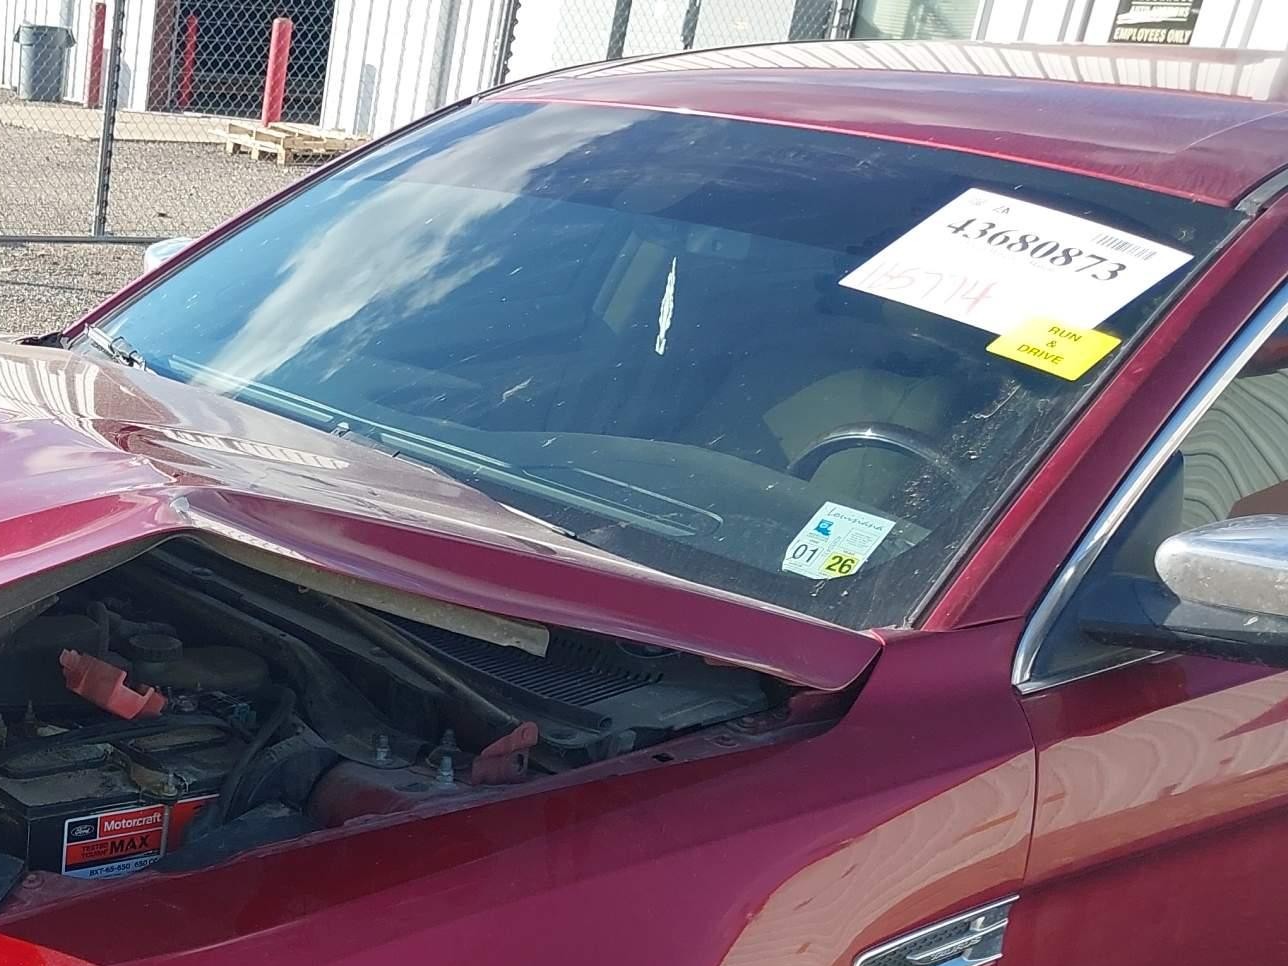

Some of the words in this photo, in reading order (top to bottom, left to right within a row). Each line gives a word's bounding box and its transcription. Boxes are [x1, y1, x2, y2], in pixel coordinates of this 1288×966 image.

[1113, 27, 1166, 42] EMPLOYEES
[1167, 29, 1192, 43] ONLY
[947, 218, 1127, 281] 43680873
[1048, 326, 1082, 342] RUN
[1046, 340, 1057, 348] &
[1016, 344, 1064, 365] DRIVE
[792, 544, 819, 563] 01
[825, 555, 855, 574] 26
[103, 812, 161, 831] Motorcraft
[109, 835, 150, 854] MAX
